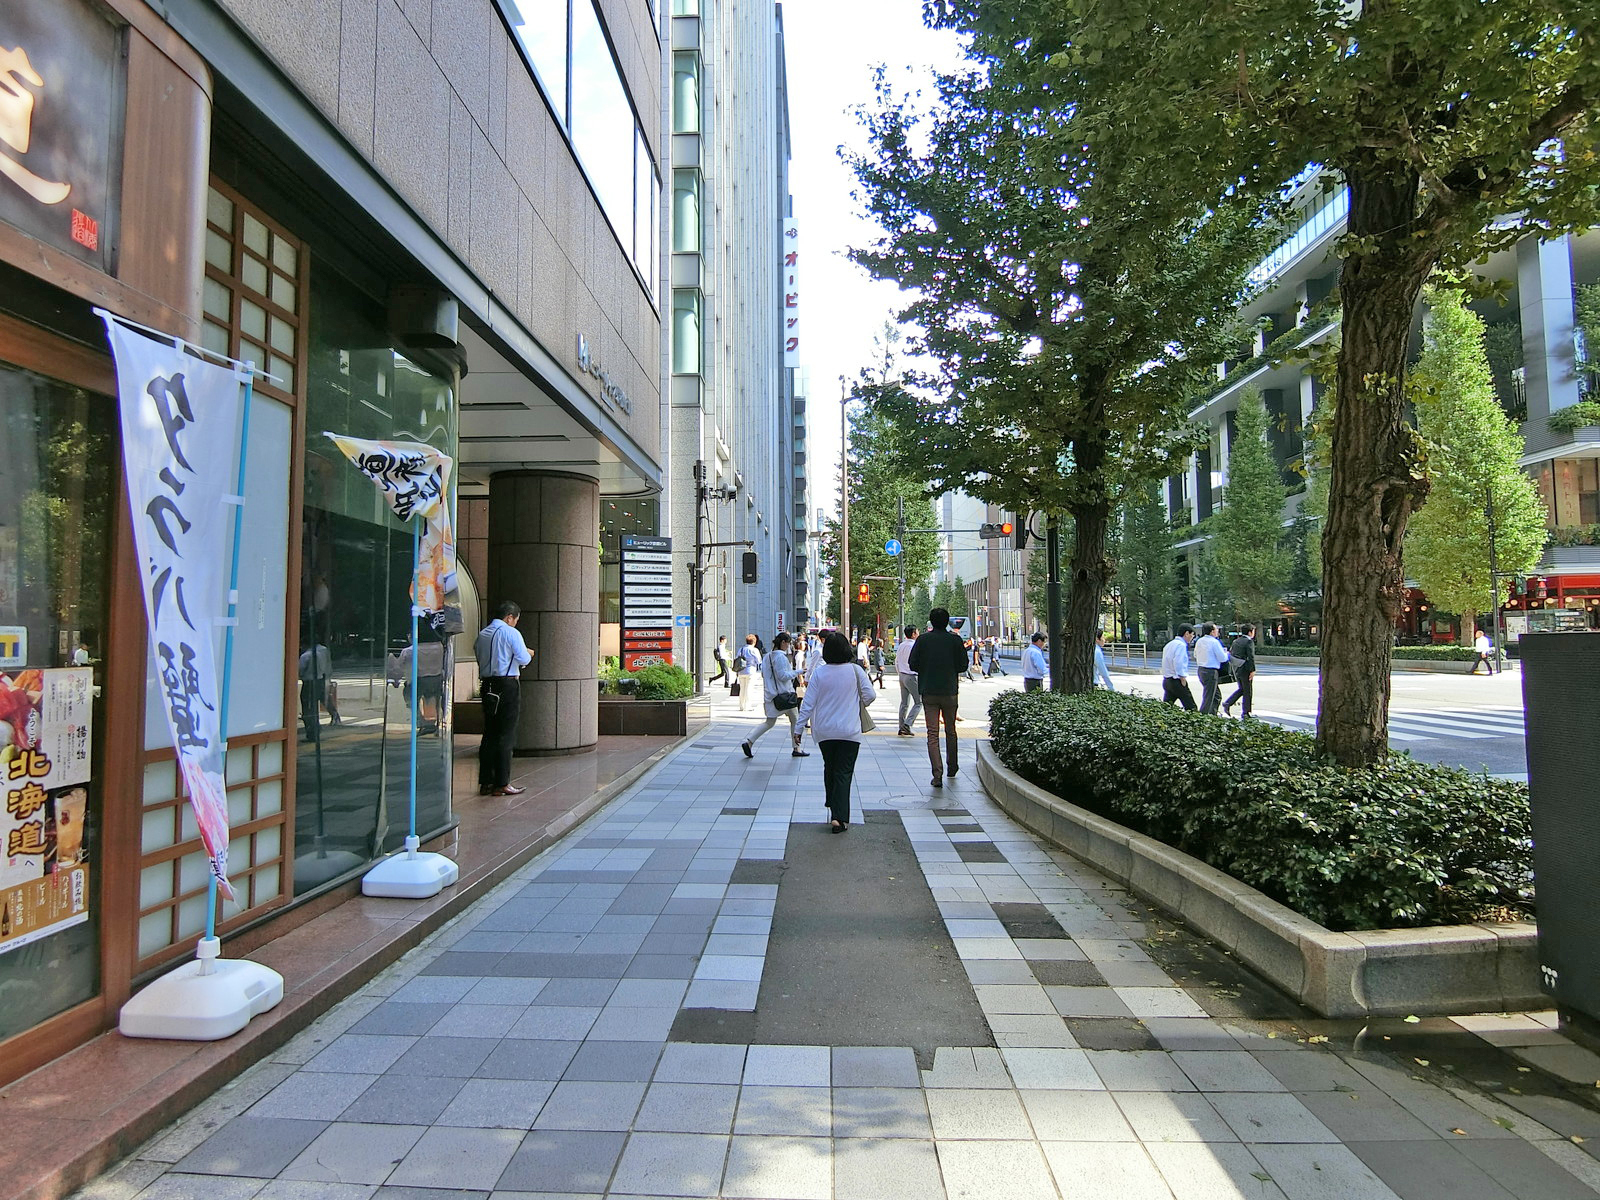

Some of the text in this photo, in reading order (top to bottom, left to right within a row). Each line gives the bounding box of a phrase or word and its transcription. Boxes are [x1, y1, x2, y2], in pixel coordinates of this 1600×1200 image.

[785, 251, 798, 352] オービック
[777, 614, 785, 632] meiji
[76, 677, 87, 705] 刺身
[76, 725, 87, 760] 揚げ物
[7, 748, 51, 858] 北海道
